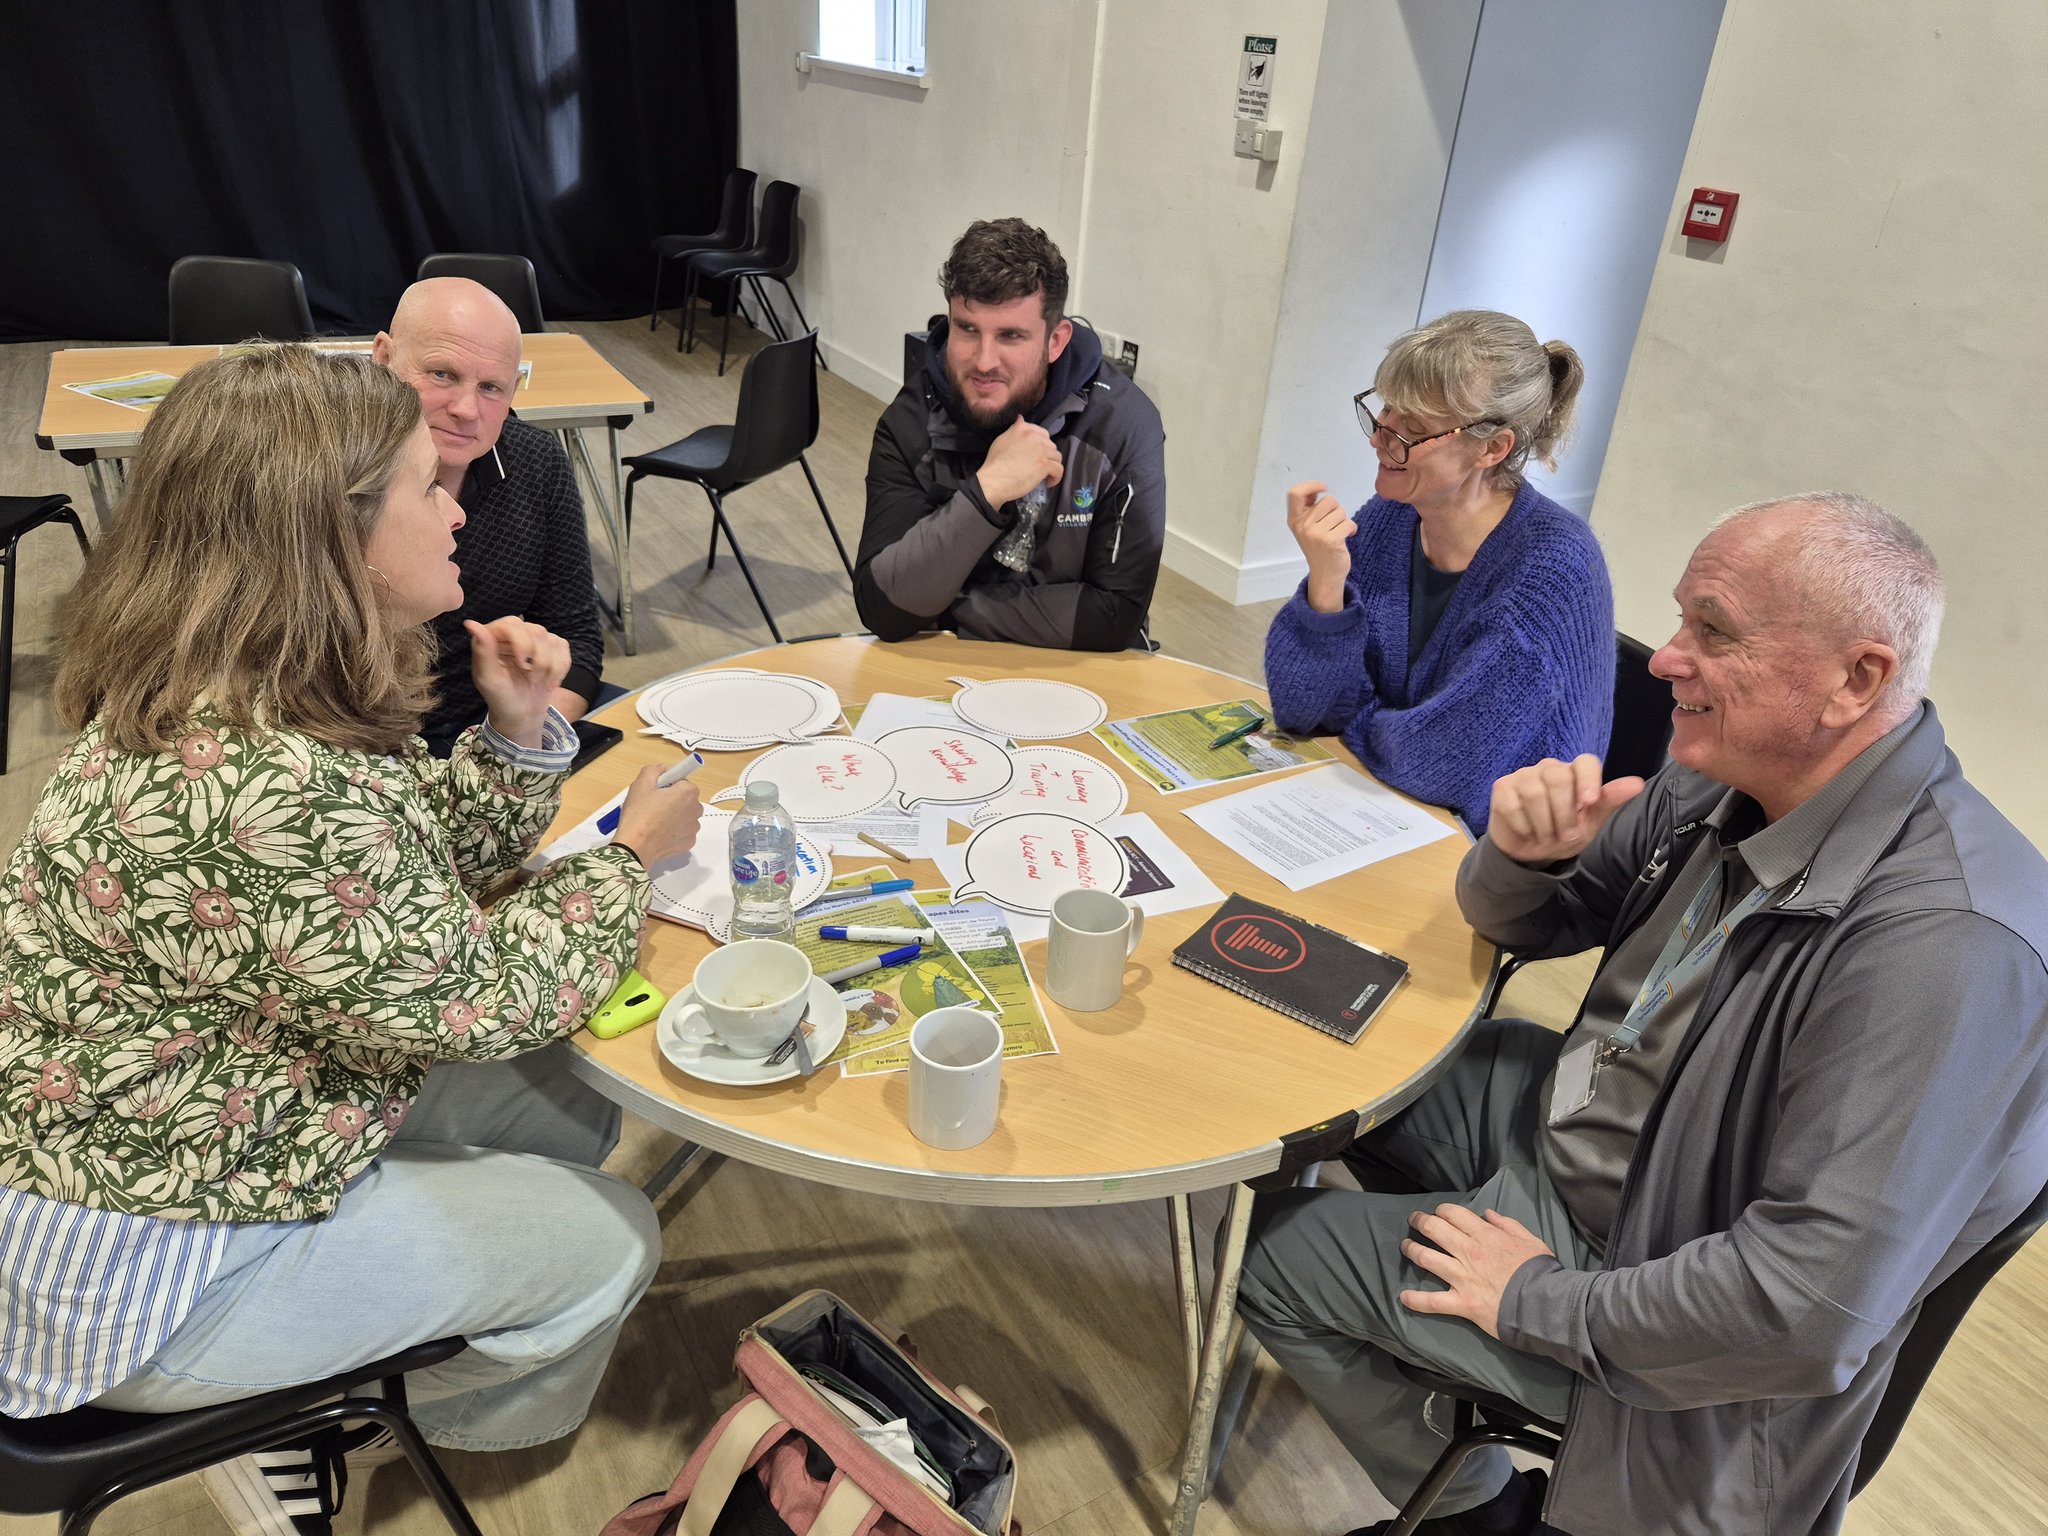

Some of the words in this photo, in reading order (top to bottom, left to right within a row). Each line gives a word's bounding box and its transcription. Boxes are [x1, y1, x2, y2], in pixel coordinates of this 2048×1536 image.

[1247, 39, 1274, 53] Please
[1057, 513, 1093, 523] CAMBR
[841, 754, 863, 777] What
[943, 739, 978, 767] Sharing
[815, 765, 845, 791] else?
[1020, 762, 1048, 798] Training
[1066, 769, 1094, 804] Learning
[1050, 850, 1069, 869] and
[1071, 828, 1097, 889] Communicatio
